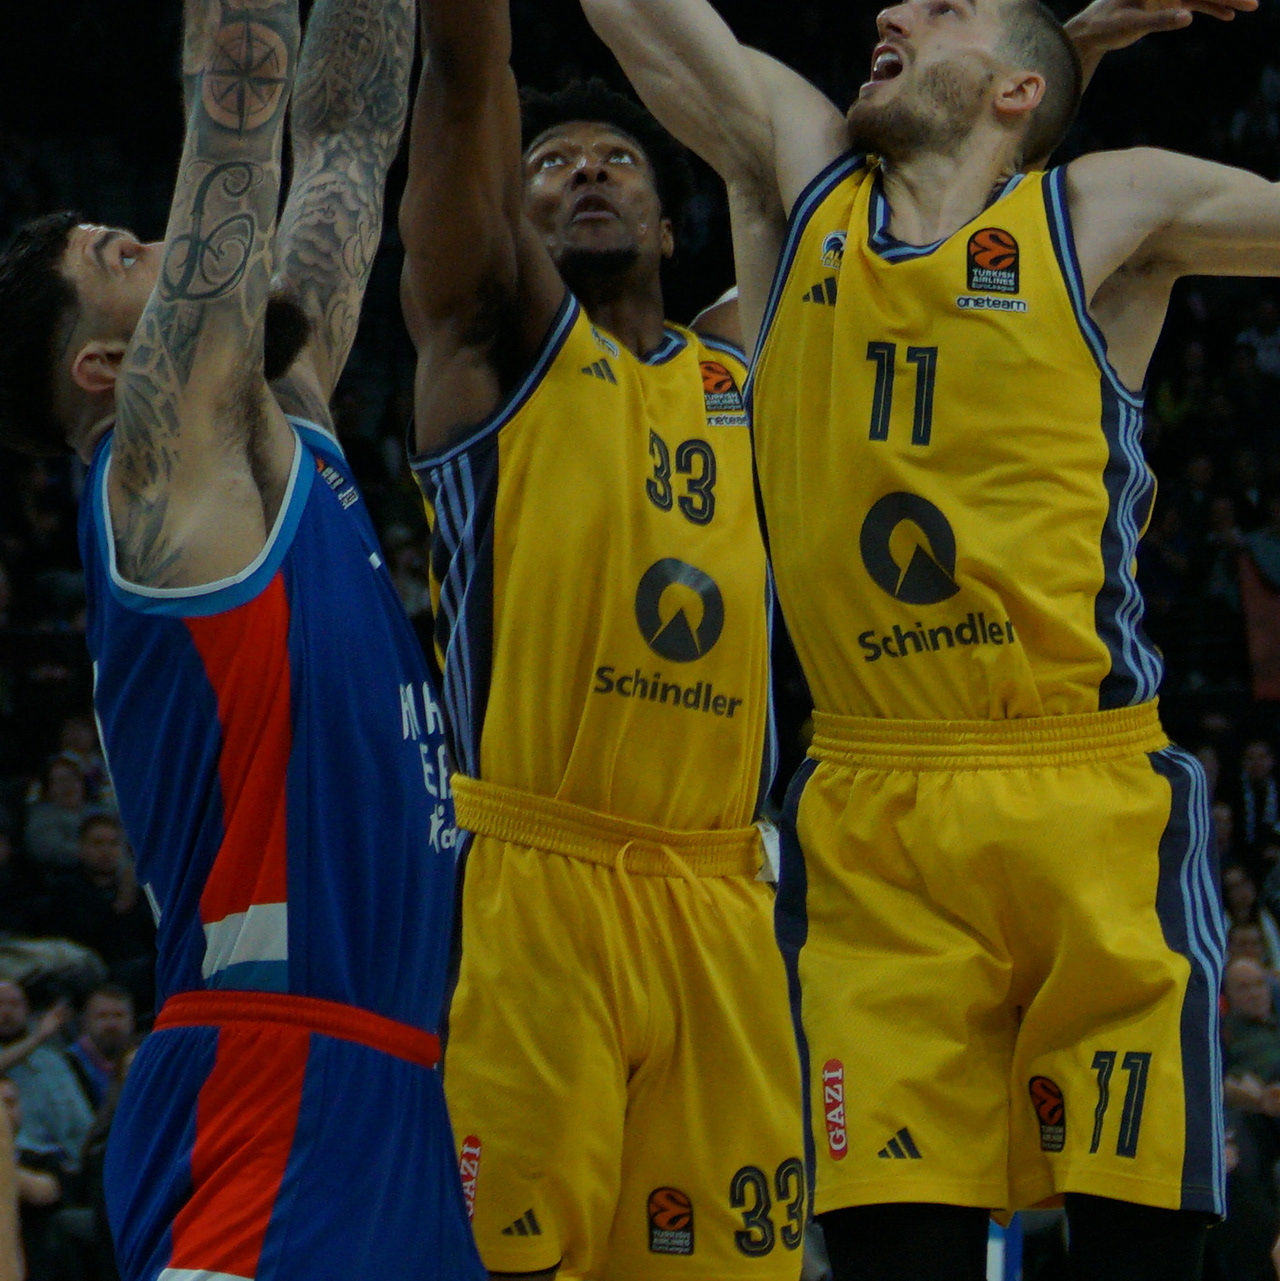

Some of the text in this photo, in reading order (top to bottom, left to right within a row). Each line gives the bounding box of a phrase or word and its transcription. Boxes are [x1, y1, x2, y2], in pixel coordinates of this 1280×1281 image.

[957, 296, 1027, 312] oneteam
[866, 341, 938, 447] 11
[646, 428, 717, 527] 33
[858, 612, 1016, 662] Schindler
[594, 666, 743, 719] Schindler
[1089, 1051, 1152, 1159] 11
[730, 1157, 804, 1257] 33
